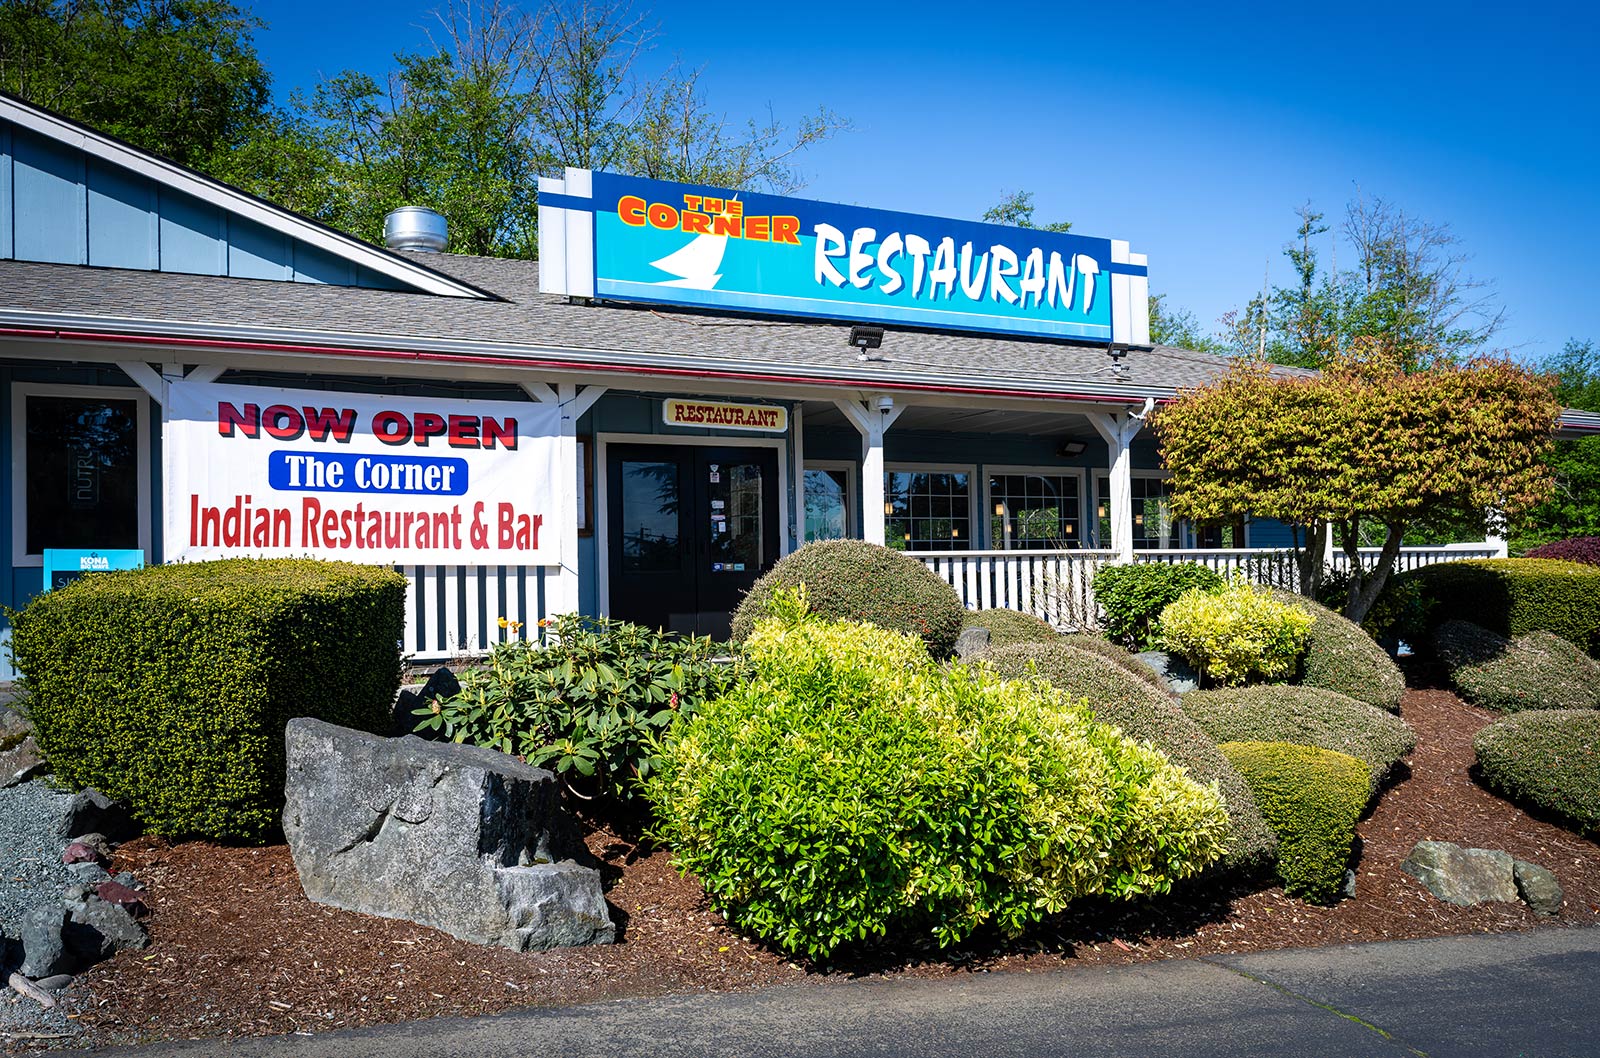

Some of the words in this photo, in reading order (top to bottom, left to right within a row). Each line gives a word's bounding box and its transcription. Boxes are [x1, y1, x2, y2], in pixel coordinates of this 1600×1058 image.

[617, 195, 802, 246] CORNER
[684, 194, 744, 217] THE
[813, 222, 1099, 316] RESTAURANT
[218, 401, 358, 443] NOW
[372, 410, 518, 451] OPEN
[674, 404, 778, 427] RESTAURANT
[285, 455, 344, 488] The
[354, 457, 456, 491] Corner
[190, 494, 292, 548] Indian
[302, 497, 462, 550] Restaurant
[469, 501, 490, 550] &
[498, 502, 543, 550] Bar
[80, 556, 109, 565] KONA
